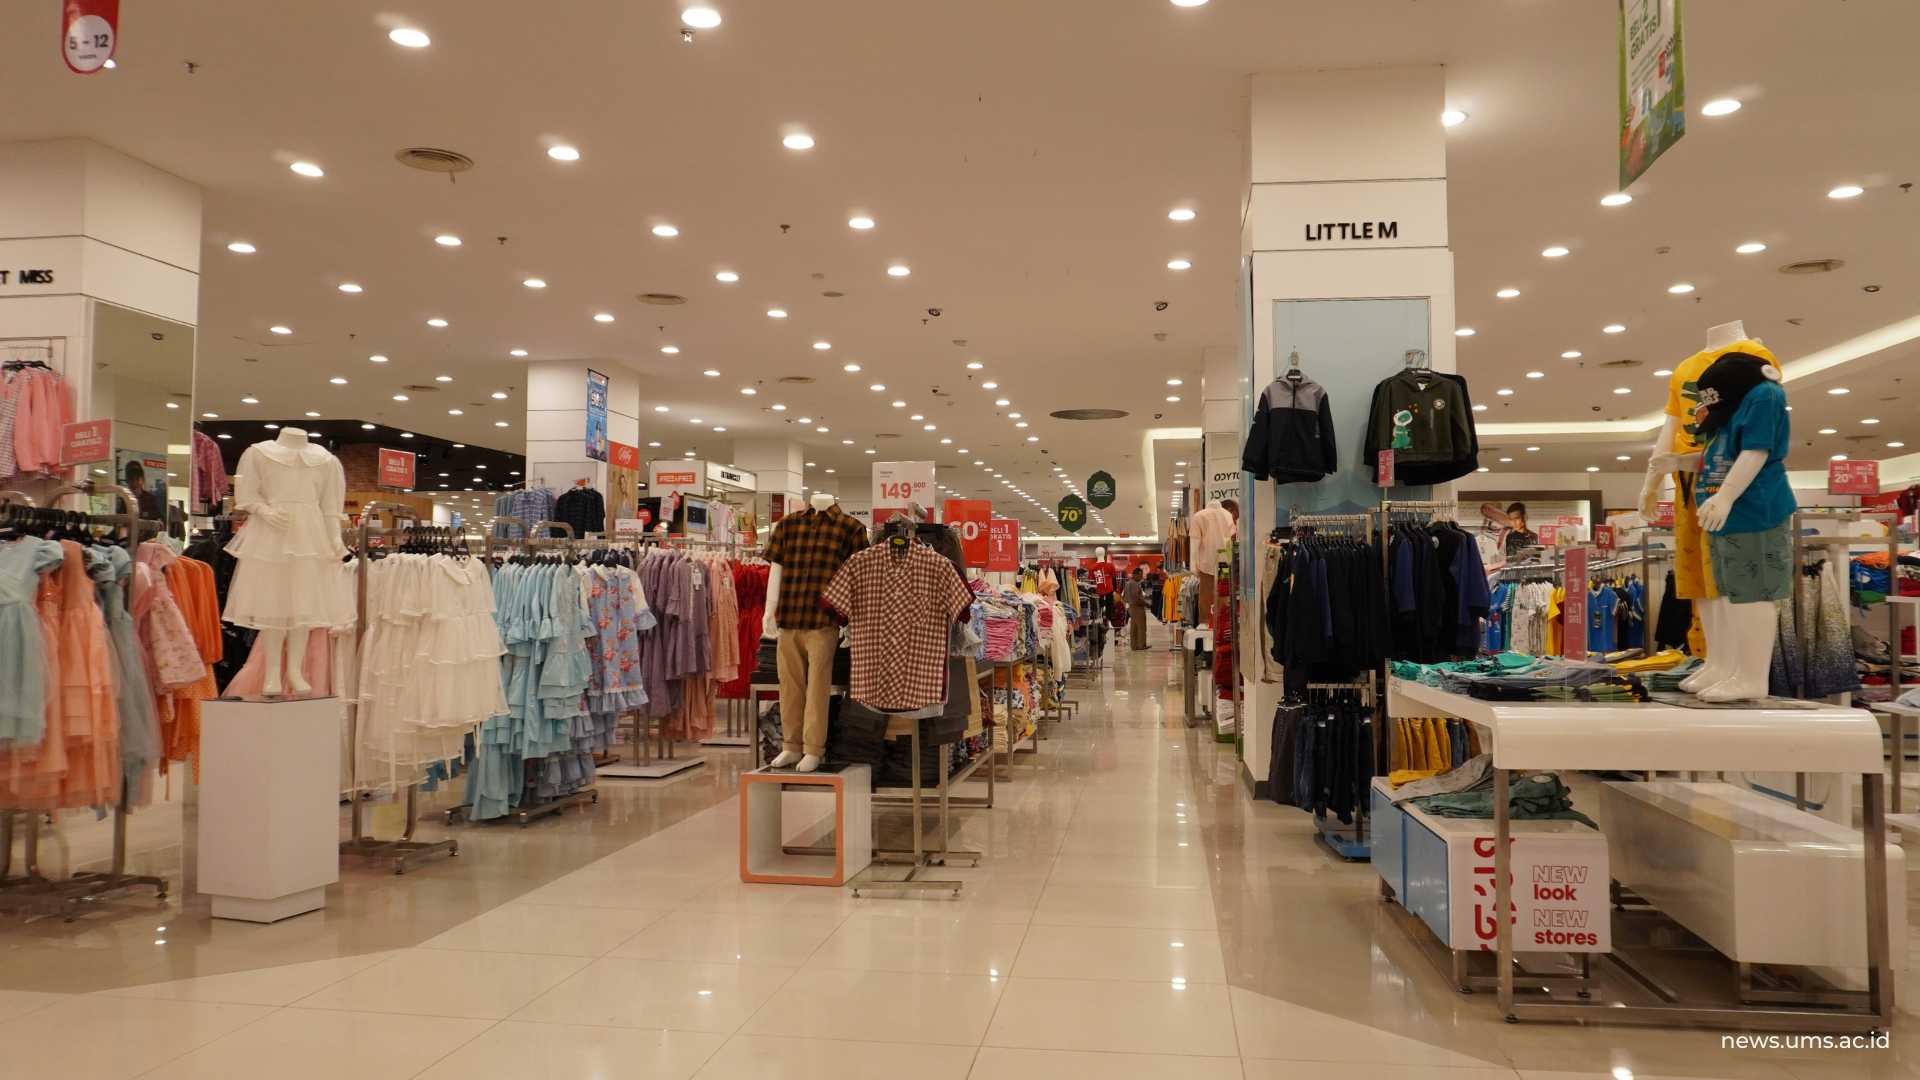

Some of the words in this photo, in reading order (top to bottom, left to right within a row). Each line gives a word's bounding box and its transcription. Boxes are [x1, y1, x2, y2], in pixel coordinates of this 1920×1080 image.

[69, 36, 77, 50] 5
[94, 33, 109, 49] 12
[1305, 222, 1374, 241] LITTLE
[1378, 221, 1398, 239] M
[19, 269, 54, 285] MISS
[881, 482, 912, 499] 149
[1532, 865, 1588, 883] NEW
[1534, 884, 1577, 900] look
[1533, 908, 1589, 928] NEW
[1535, 929, 1598, 945] stores
